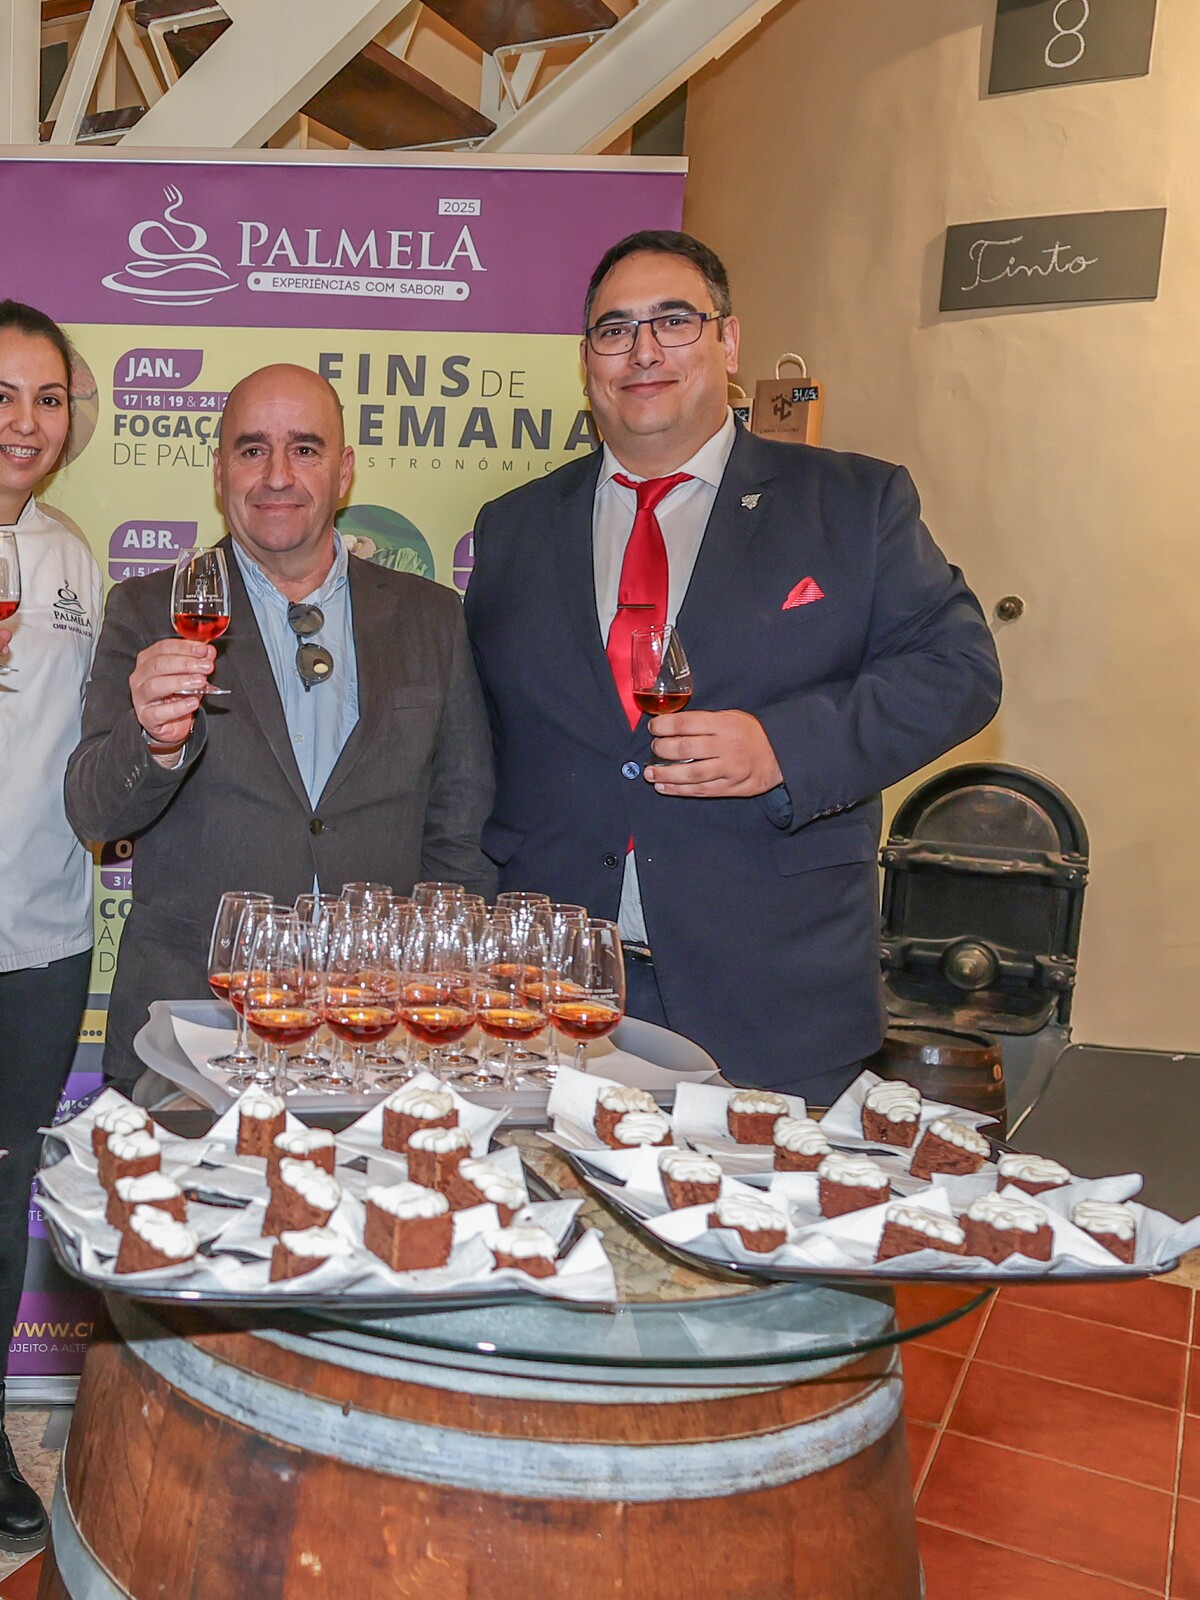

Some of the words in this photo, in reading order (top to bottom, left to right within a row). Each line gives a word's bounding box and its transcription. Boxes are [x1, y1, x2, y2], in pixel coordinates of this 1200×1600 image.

[1045, 0, 1089, 68] 8
[443, 201, 476, 213] 2025
[237, 221, 487, 271] PALMELA
[961, 236, 1098, 291] Tinto
[272, 277, 360, 292] EXPERIÊNCIAS
[366, 281, 395, 293] COM
[400, 283, 444, 296] SABOR!
[125, 357, 181, 382] JAN.
[319, 352, 471, 398] FINS
[481, 370, 526, 398] DE
[341, 404, 599, 451] EMANA
[113, 443, 147, 466] DE
[123, 529, 179, 549] ABR.
[53, 611, 92, 628] PALMELA
